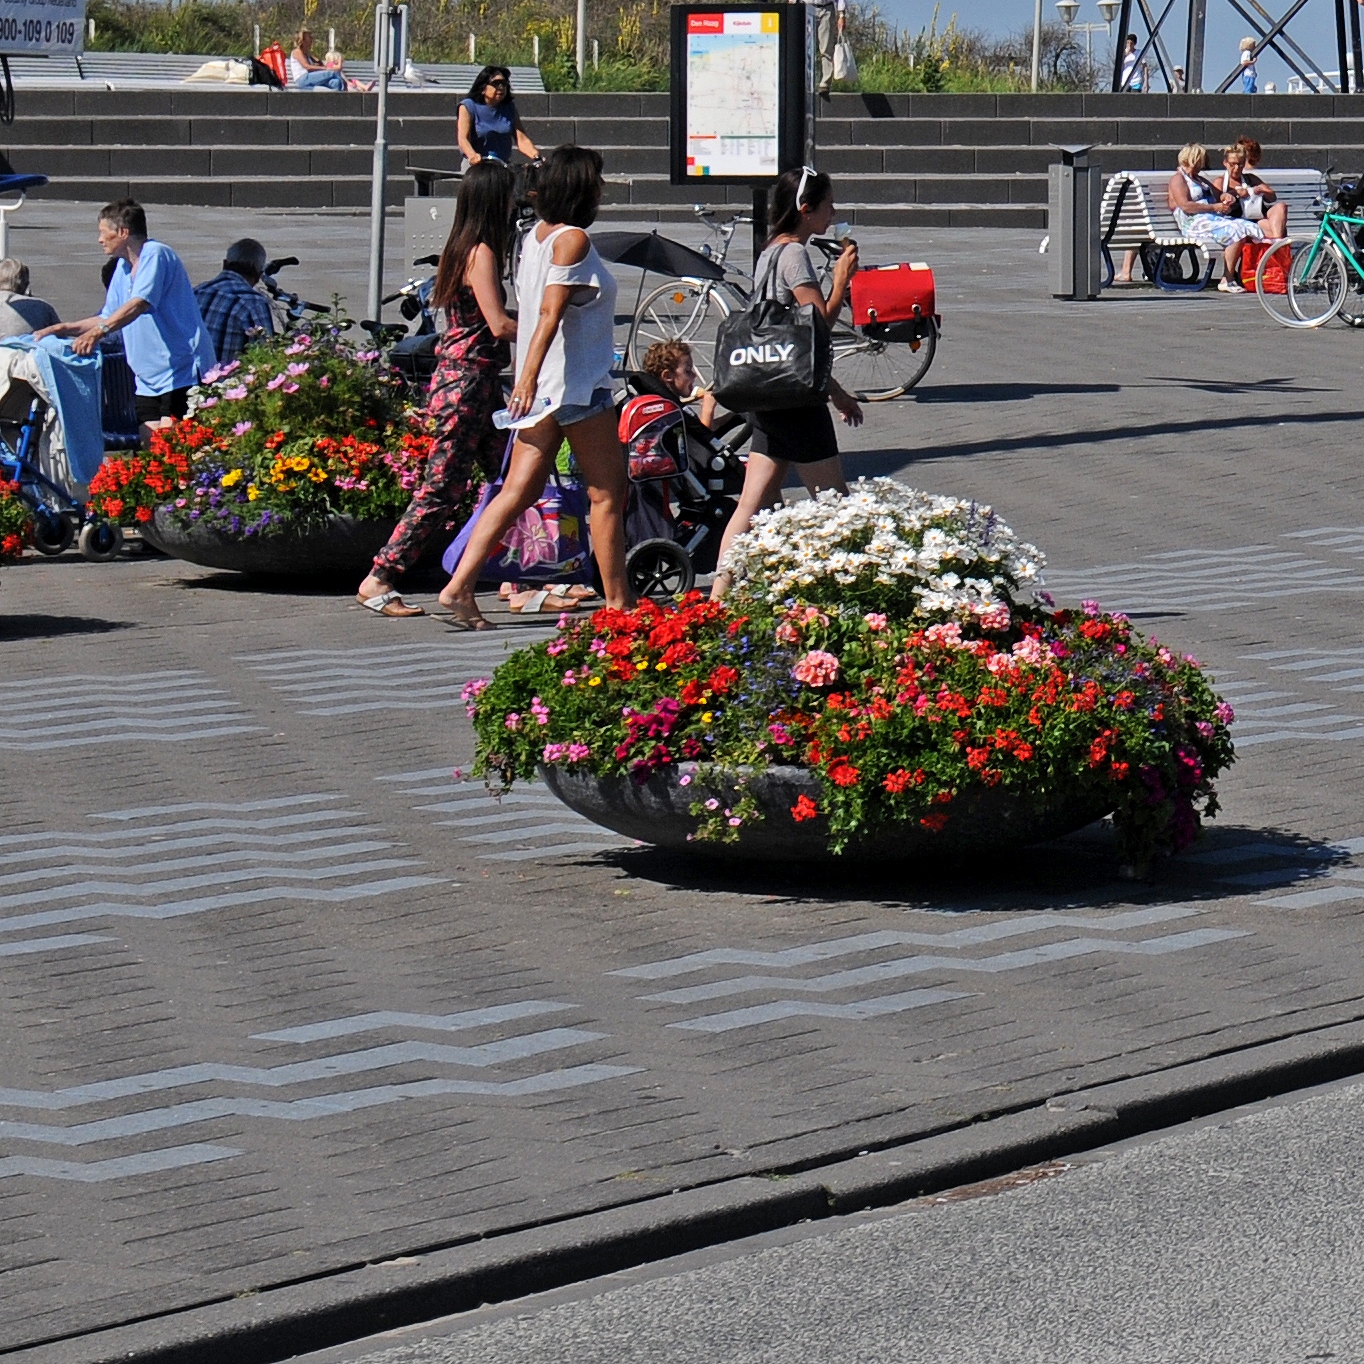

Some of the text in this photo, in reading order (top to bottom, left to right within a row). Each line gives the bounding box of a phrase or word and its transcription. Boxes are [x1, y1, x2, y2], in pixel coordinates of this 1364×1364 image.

[45, 20, 52, 43] 0
[56, 22, 75, 44] 109
[729, 343, 795, 366] ONLY
